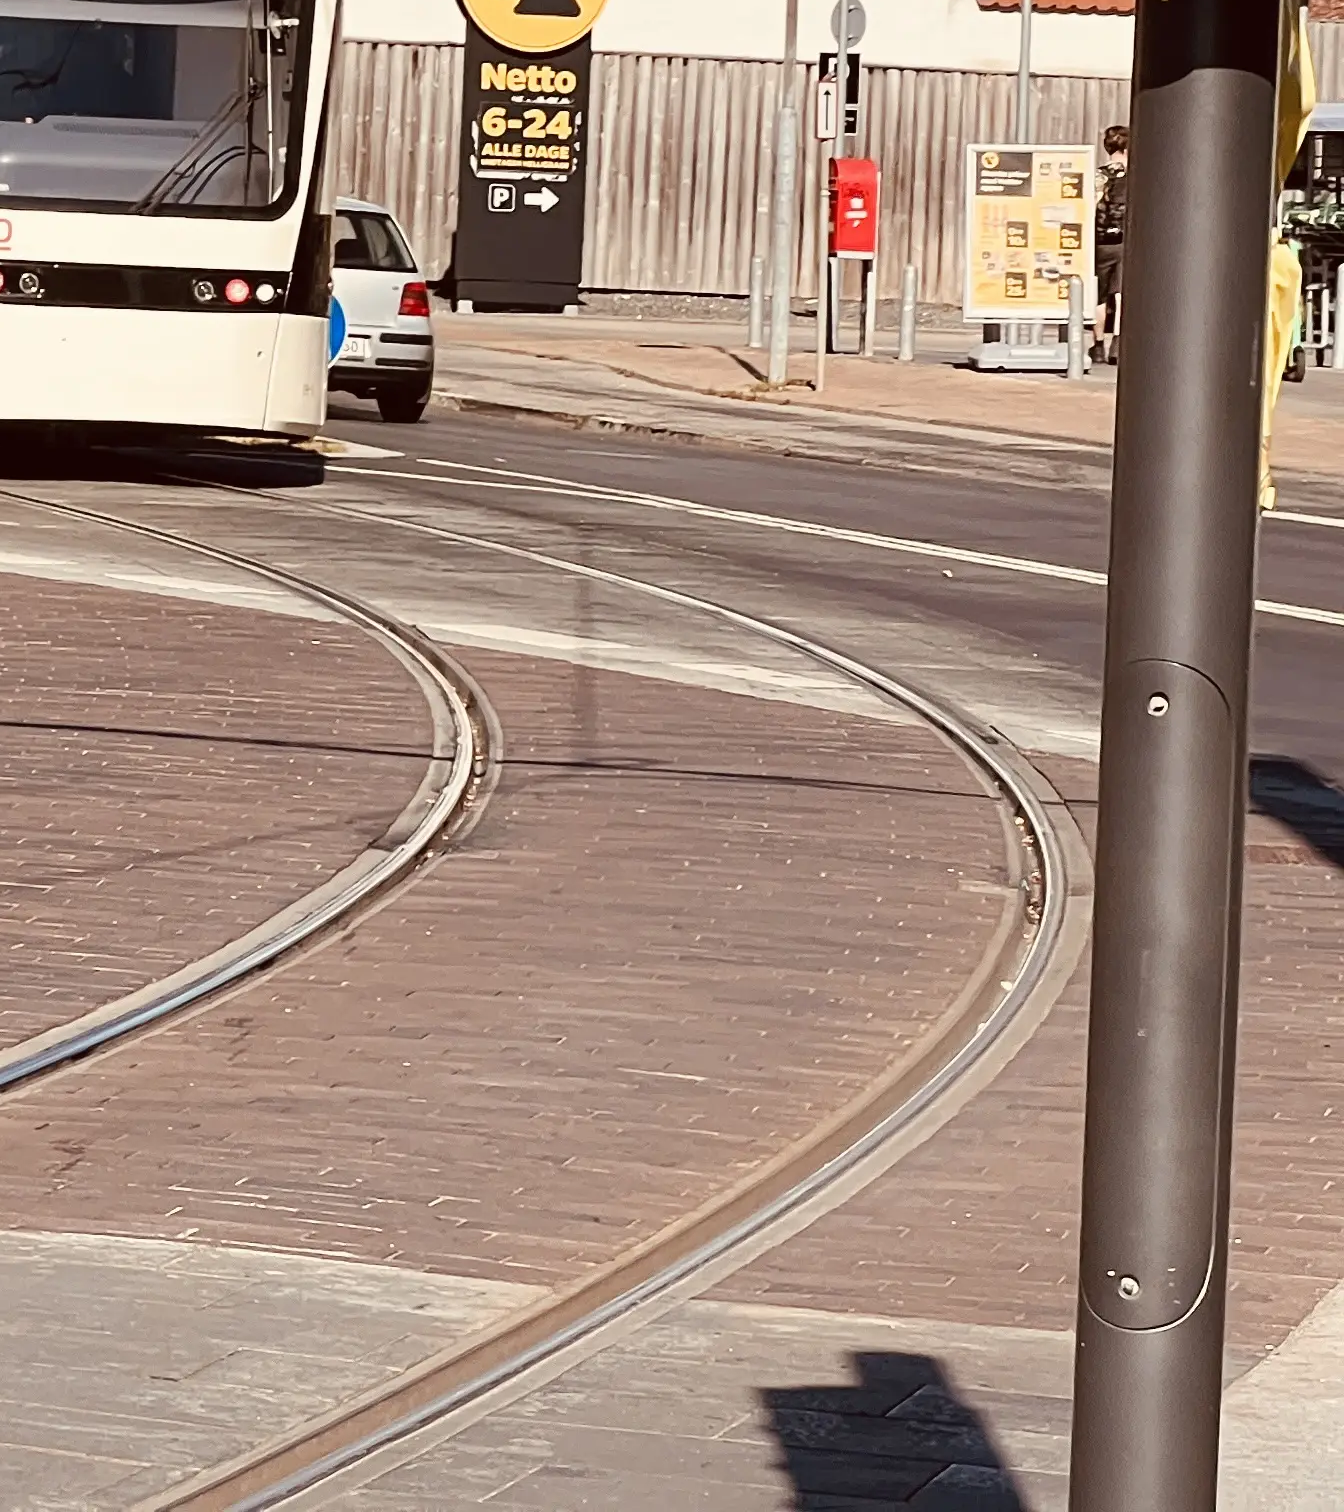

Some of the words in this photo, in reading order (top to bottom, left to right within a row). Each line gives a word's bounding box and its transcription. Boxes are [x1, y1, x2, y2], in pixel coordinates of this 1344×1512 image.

[480, 62, 577, 94] Netto
[482, 106, 573, 140] 6-24
[481, 143, 523, 157] ALLE
[524, 144, 570, 159] DAGE
[492, 187, 510, 208] P
